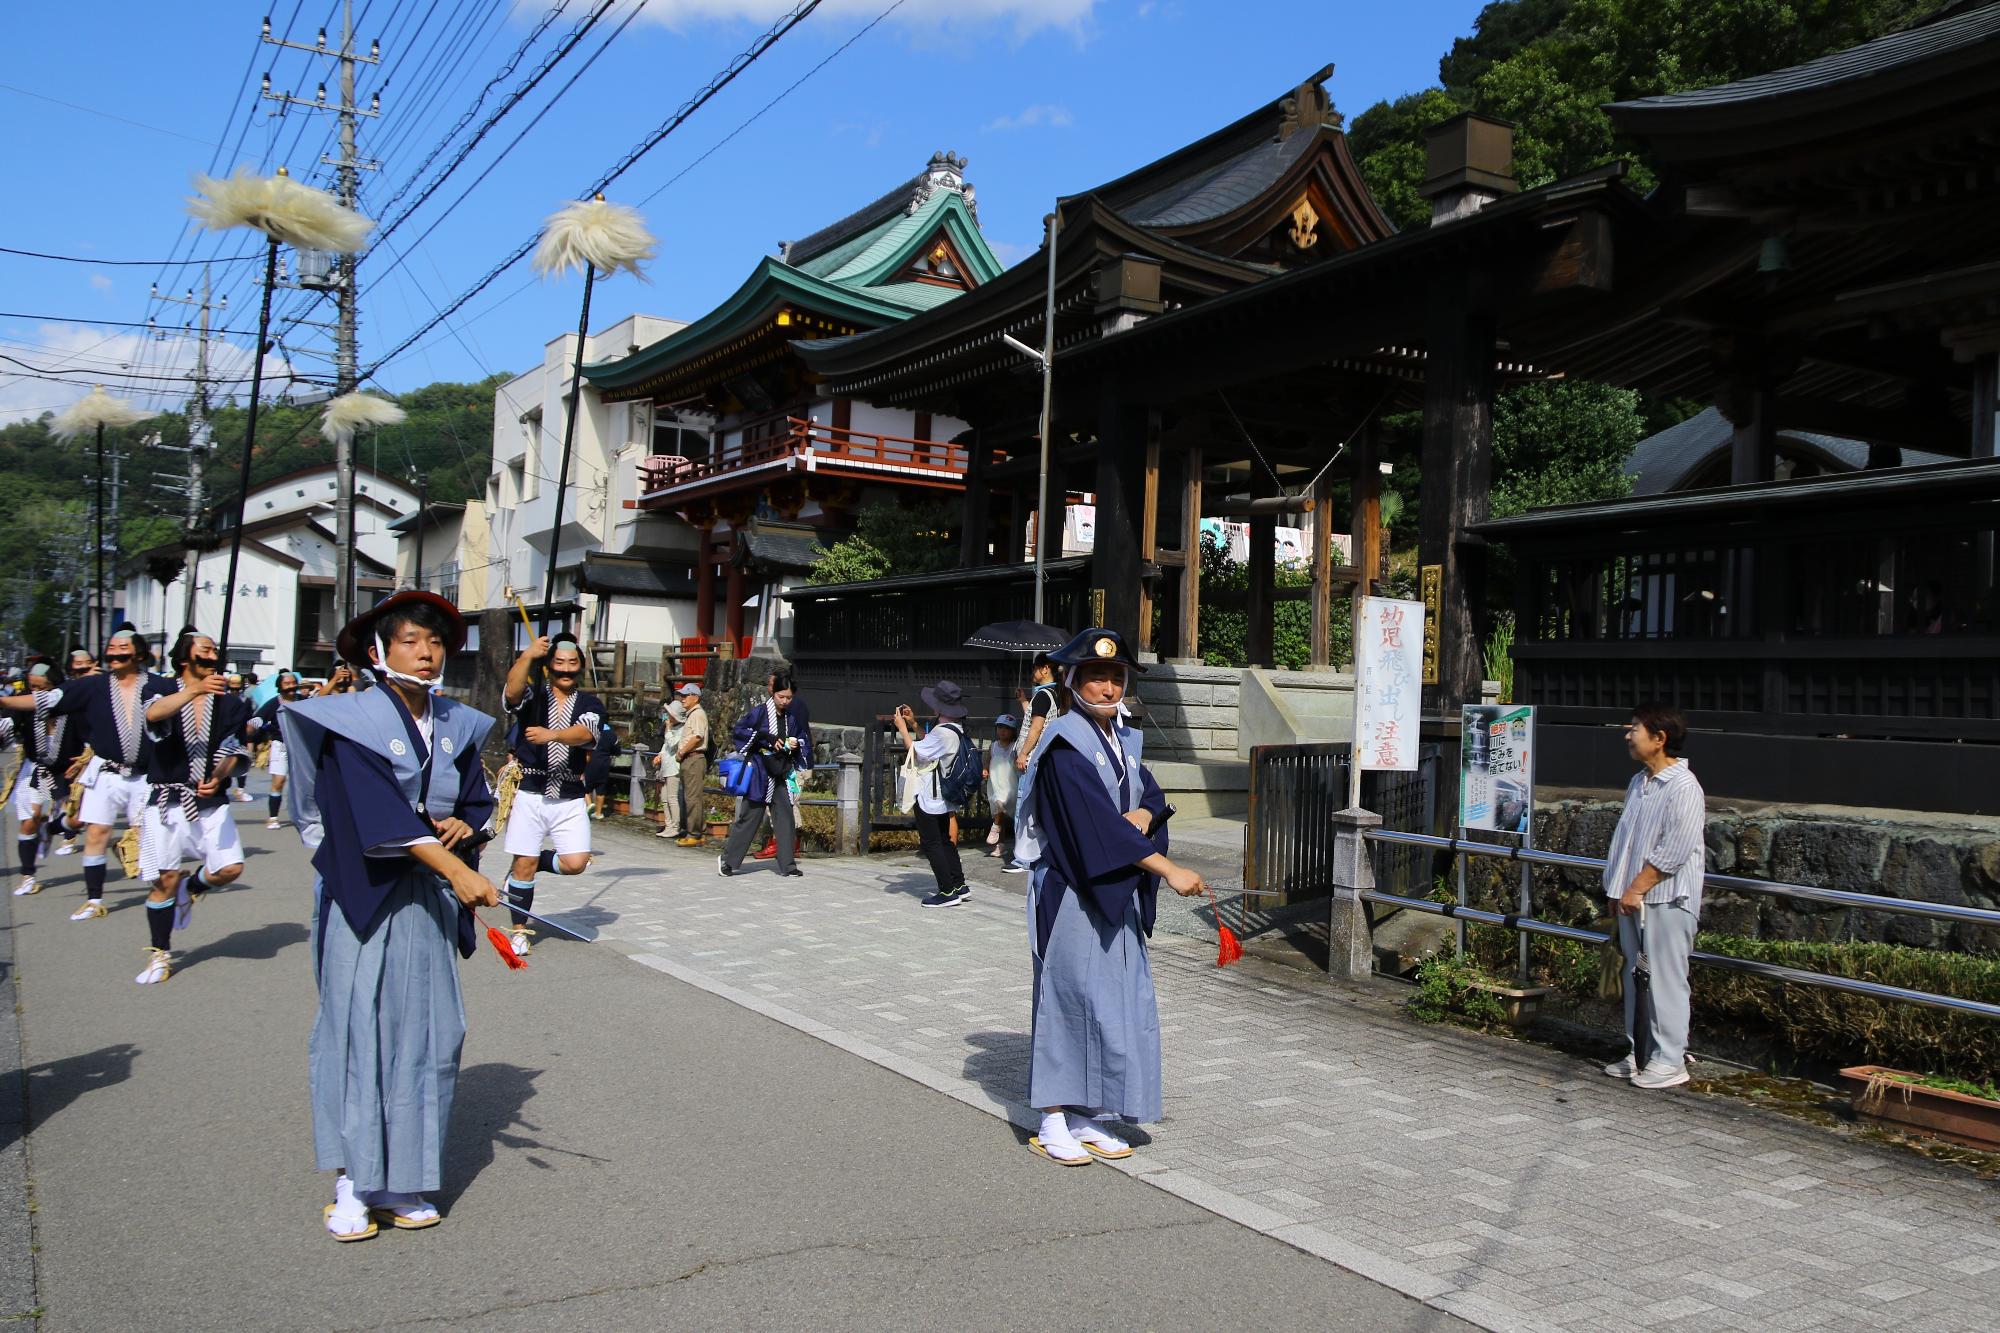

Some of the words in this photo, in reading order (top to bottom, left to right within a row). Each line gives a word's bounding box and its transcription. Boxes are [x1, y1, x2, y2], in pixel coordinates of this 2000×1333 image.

[1374, 605, 1411, 766] 幼児飛び出し注意
[1490, 736, 1506, 749] 川に
[1490, 748, 1513, 761] ごみを
